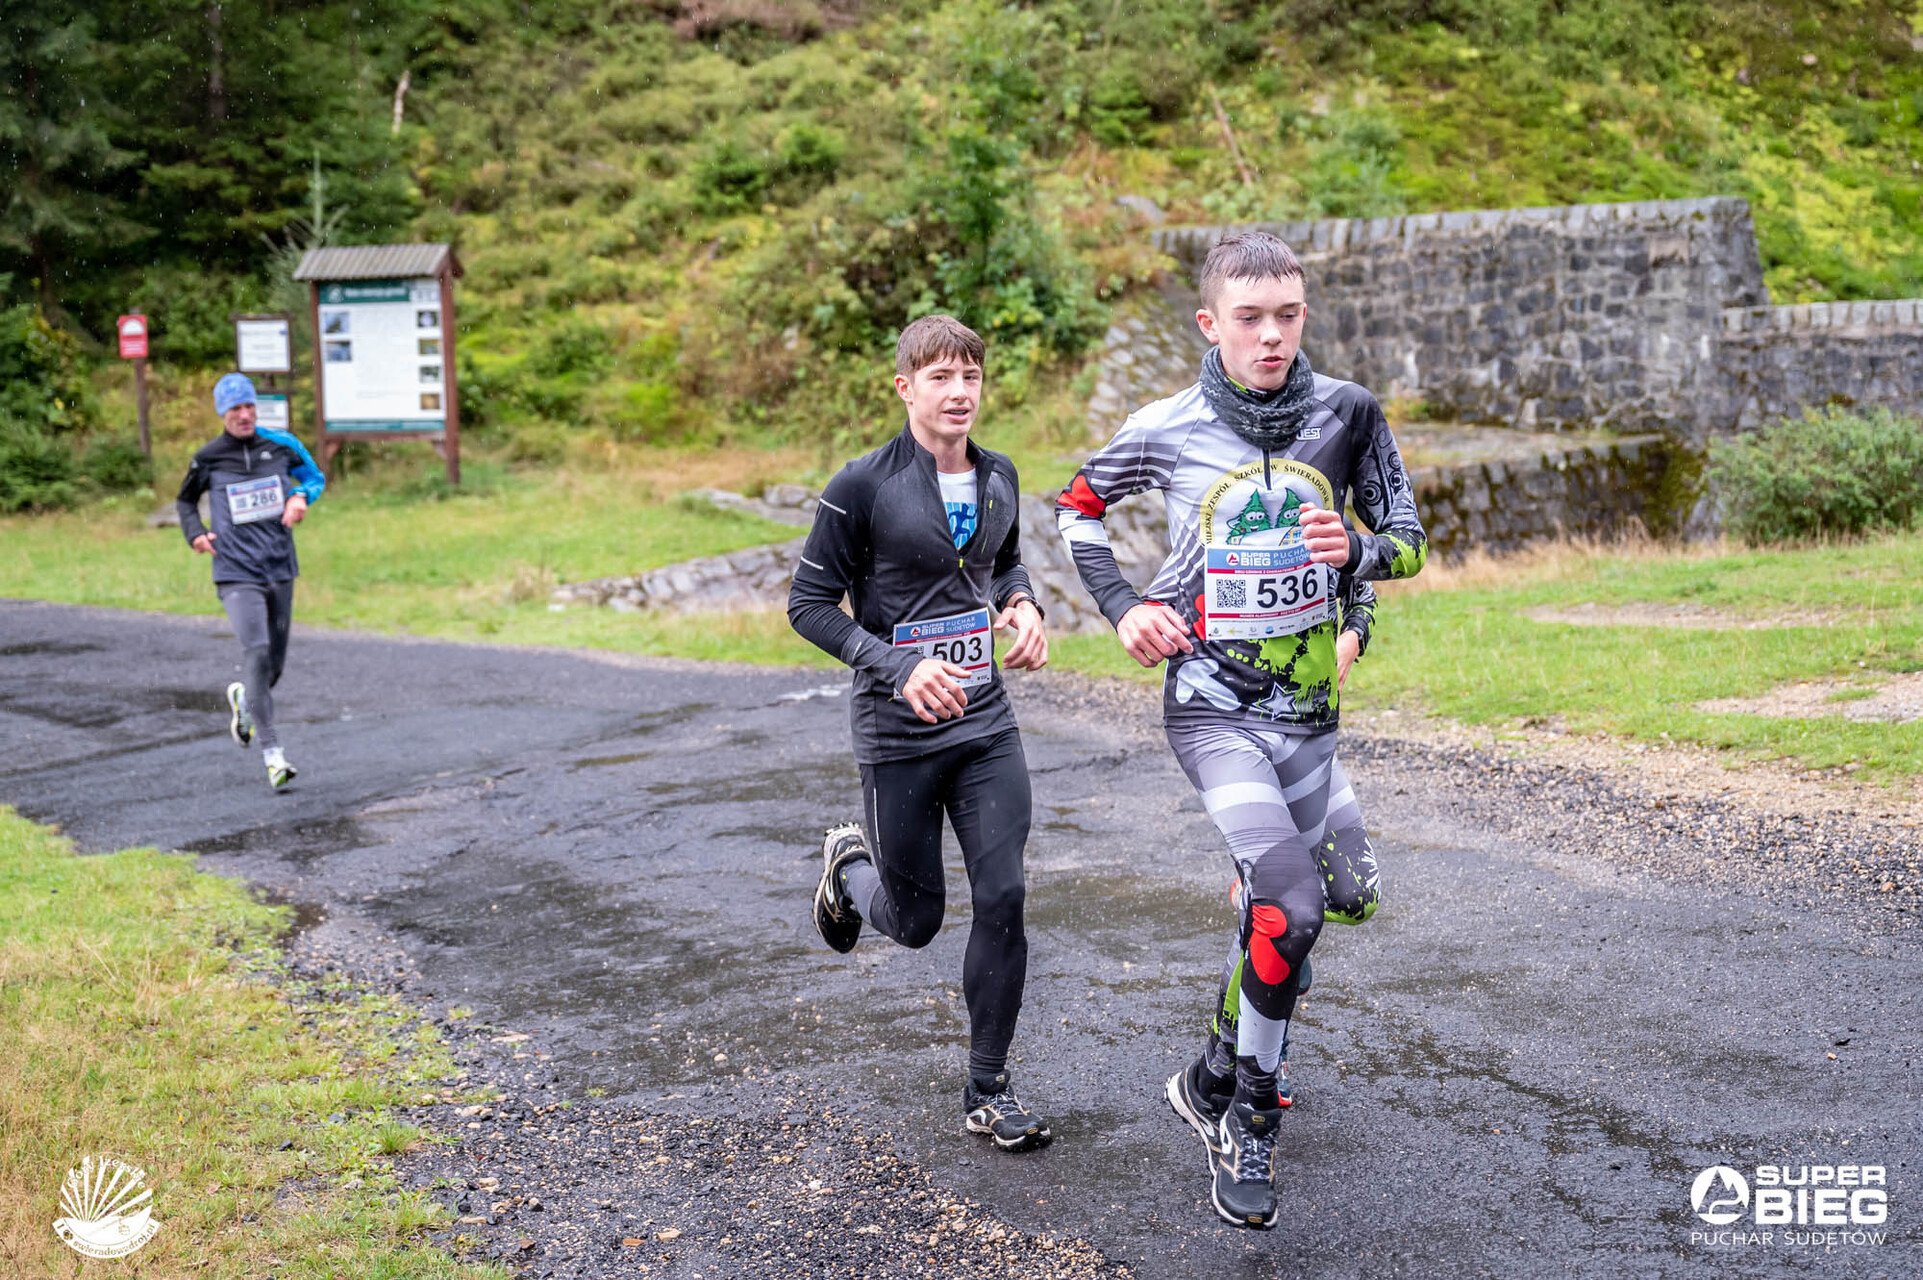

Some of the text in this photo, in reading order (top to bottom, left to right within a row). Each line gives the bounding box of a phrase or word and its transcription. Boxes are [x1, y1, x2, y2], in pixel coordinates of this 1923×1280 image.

[250, 490, 278, 507] 286
[1240, 551, 1271, 559] SUPER
[1273, 547, 1306, 560] PUCHA
[1240, 557, 1271, 567] BIEG
[1256, 567, 1318, 609] 536
[921, 621, 945, 630] SUPER
[945, 616, 976, 627] PUCHAR
[921, 626, 945, 636] BIEG
[932, 636, 983, 664] 503
